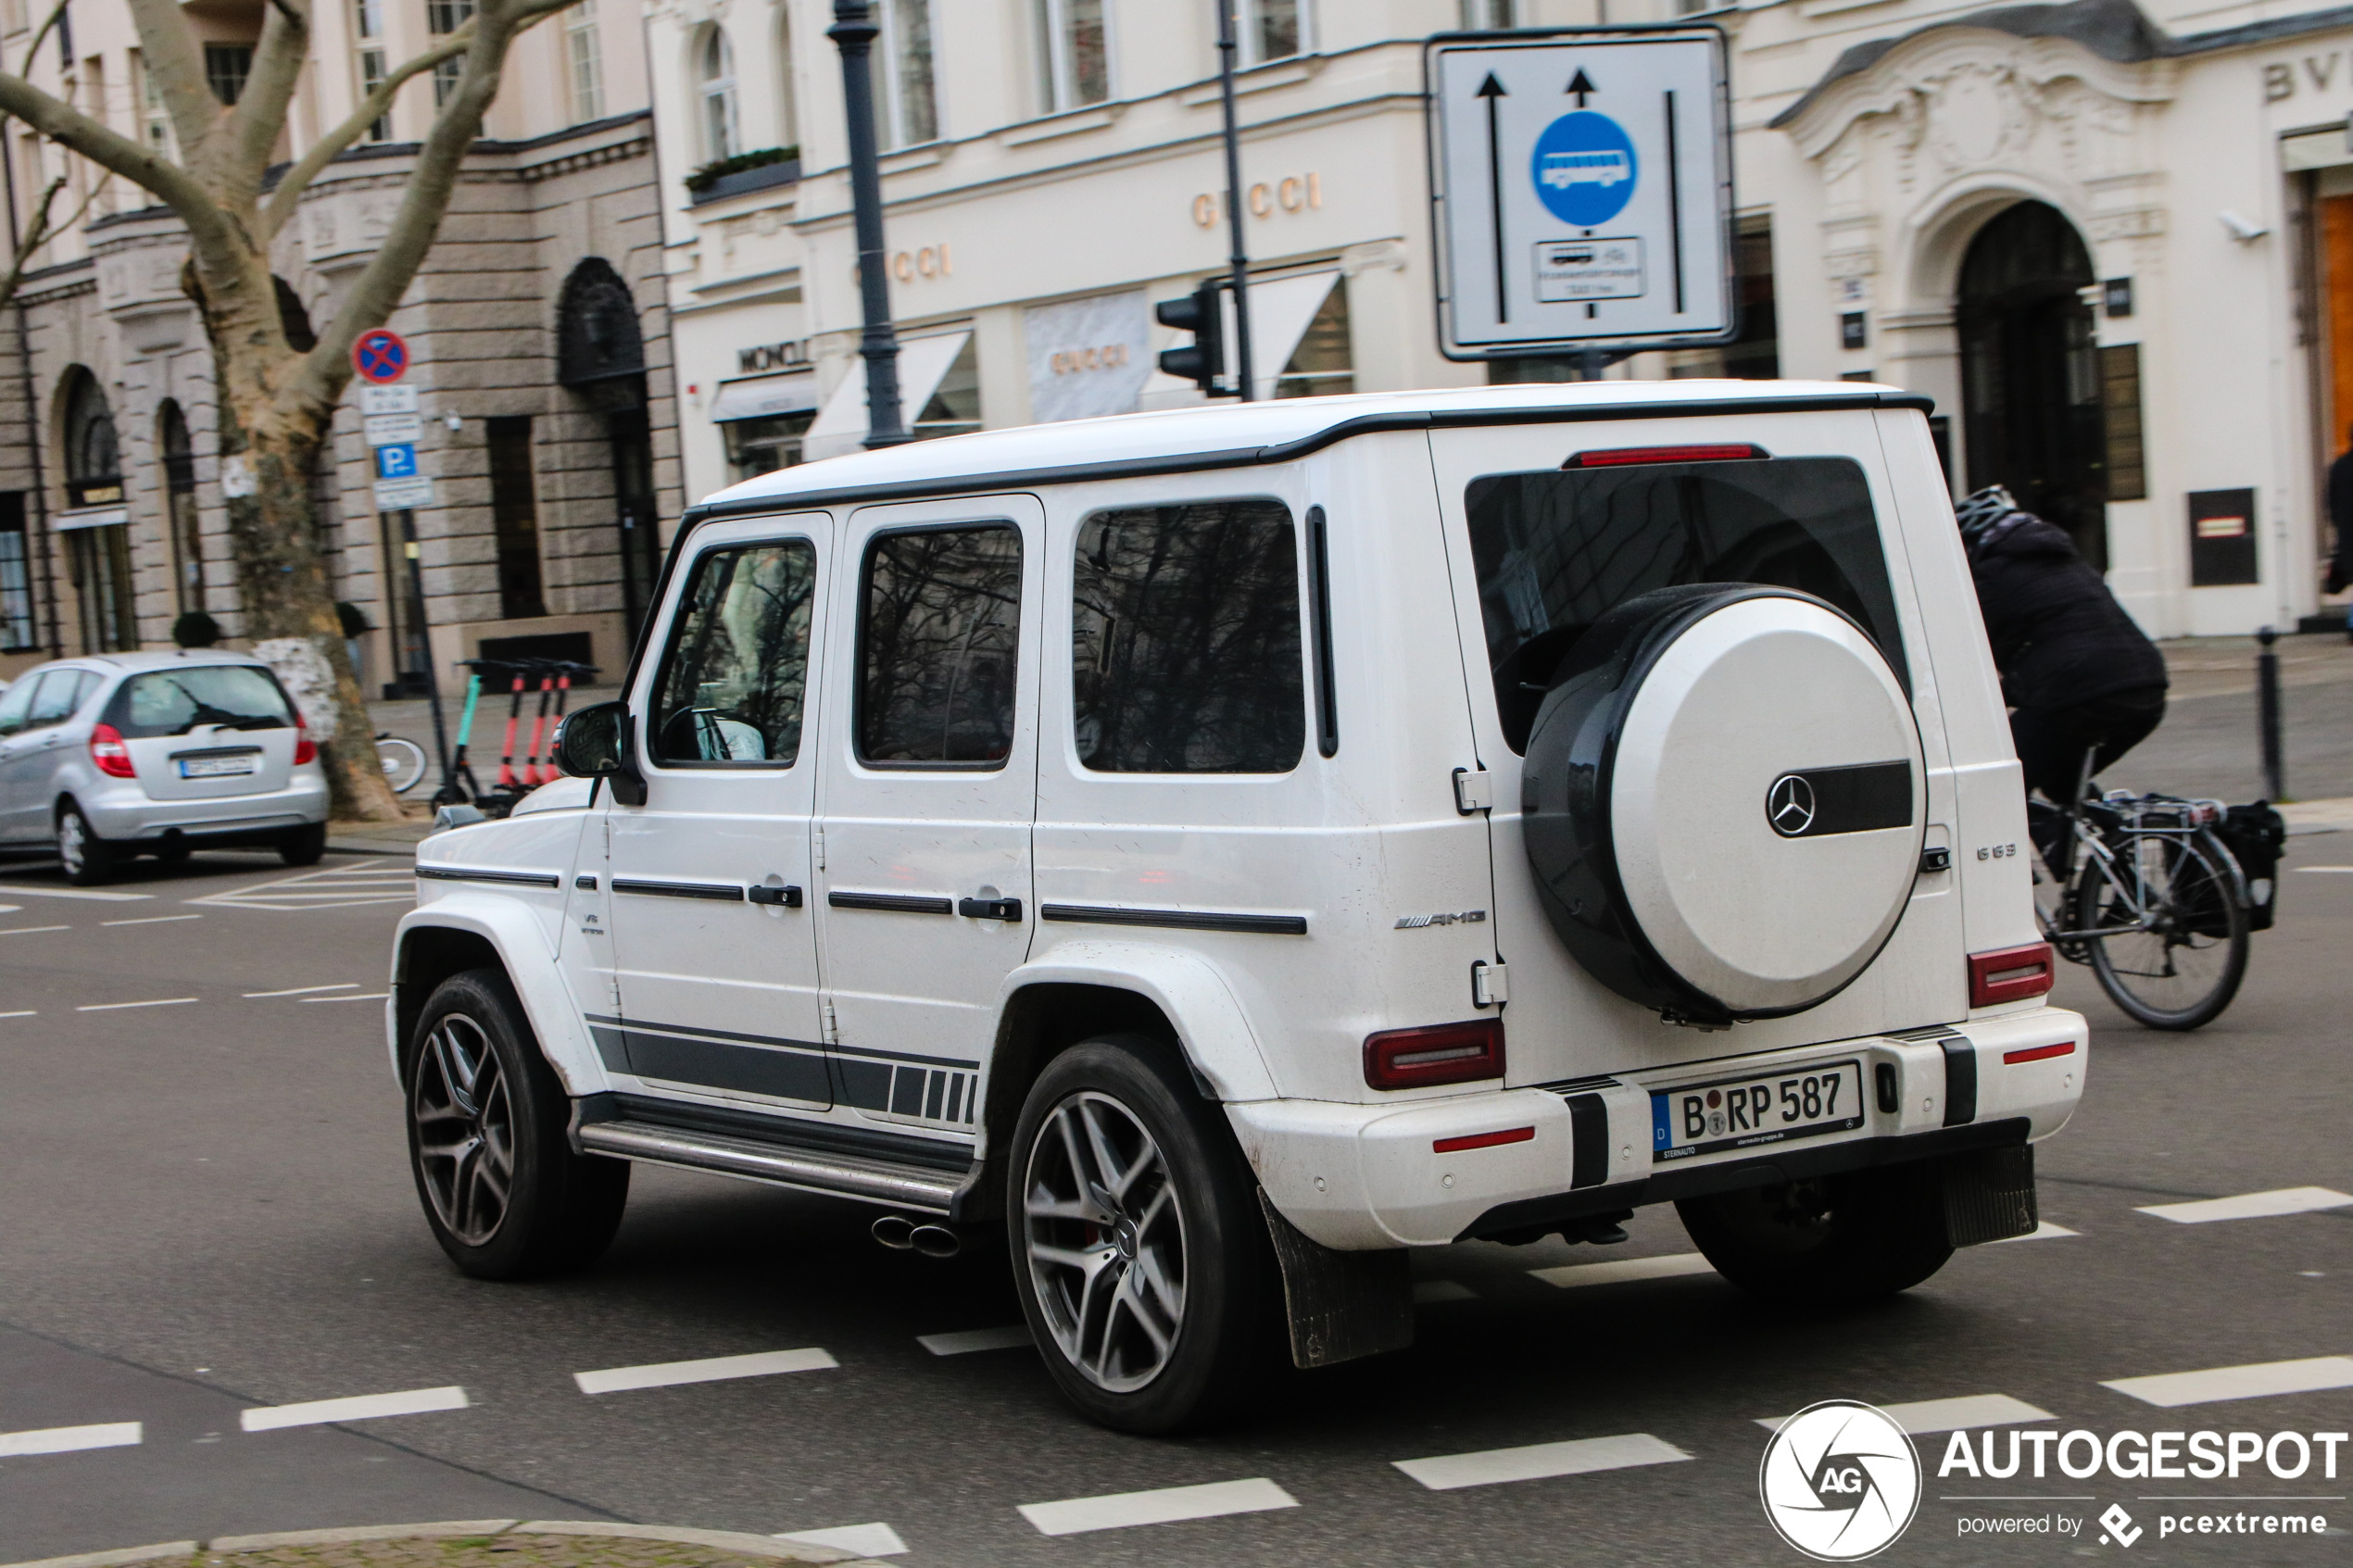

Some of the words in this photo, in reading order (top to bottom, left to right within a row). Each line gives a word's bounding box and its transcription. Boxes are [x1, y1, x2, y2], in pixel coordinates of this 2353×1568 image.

[2264, 52, 2353, 104] BV
[853, 245, 952, 286] CCI
[384, 446, 406, 474] P
[1683, 1096, 1706, 1139] B
[1727, 1085, 1771, 1132] RP
[1780, 1073, 1841, 1122] 587
[1656, 1128, 1666, 1140] D
[1737, 1133, 1784, 1146] sternauto-gruppe.de
[1664, 1147, 1695, 1159] STERNAUTO
